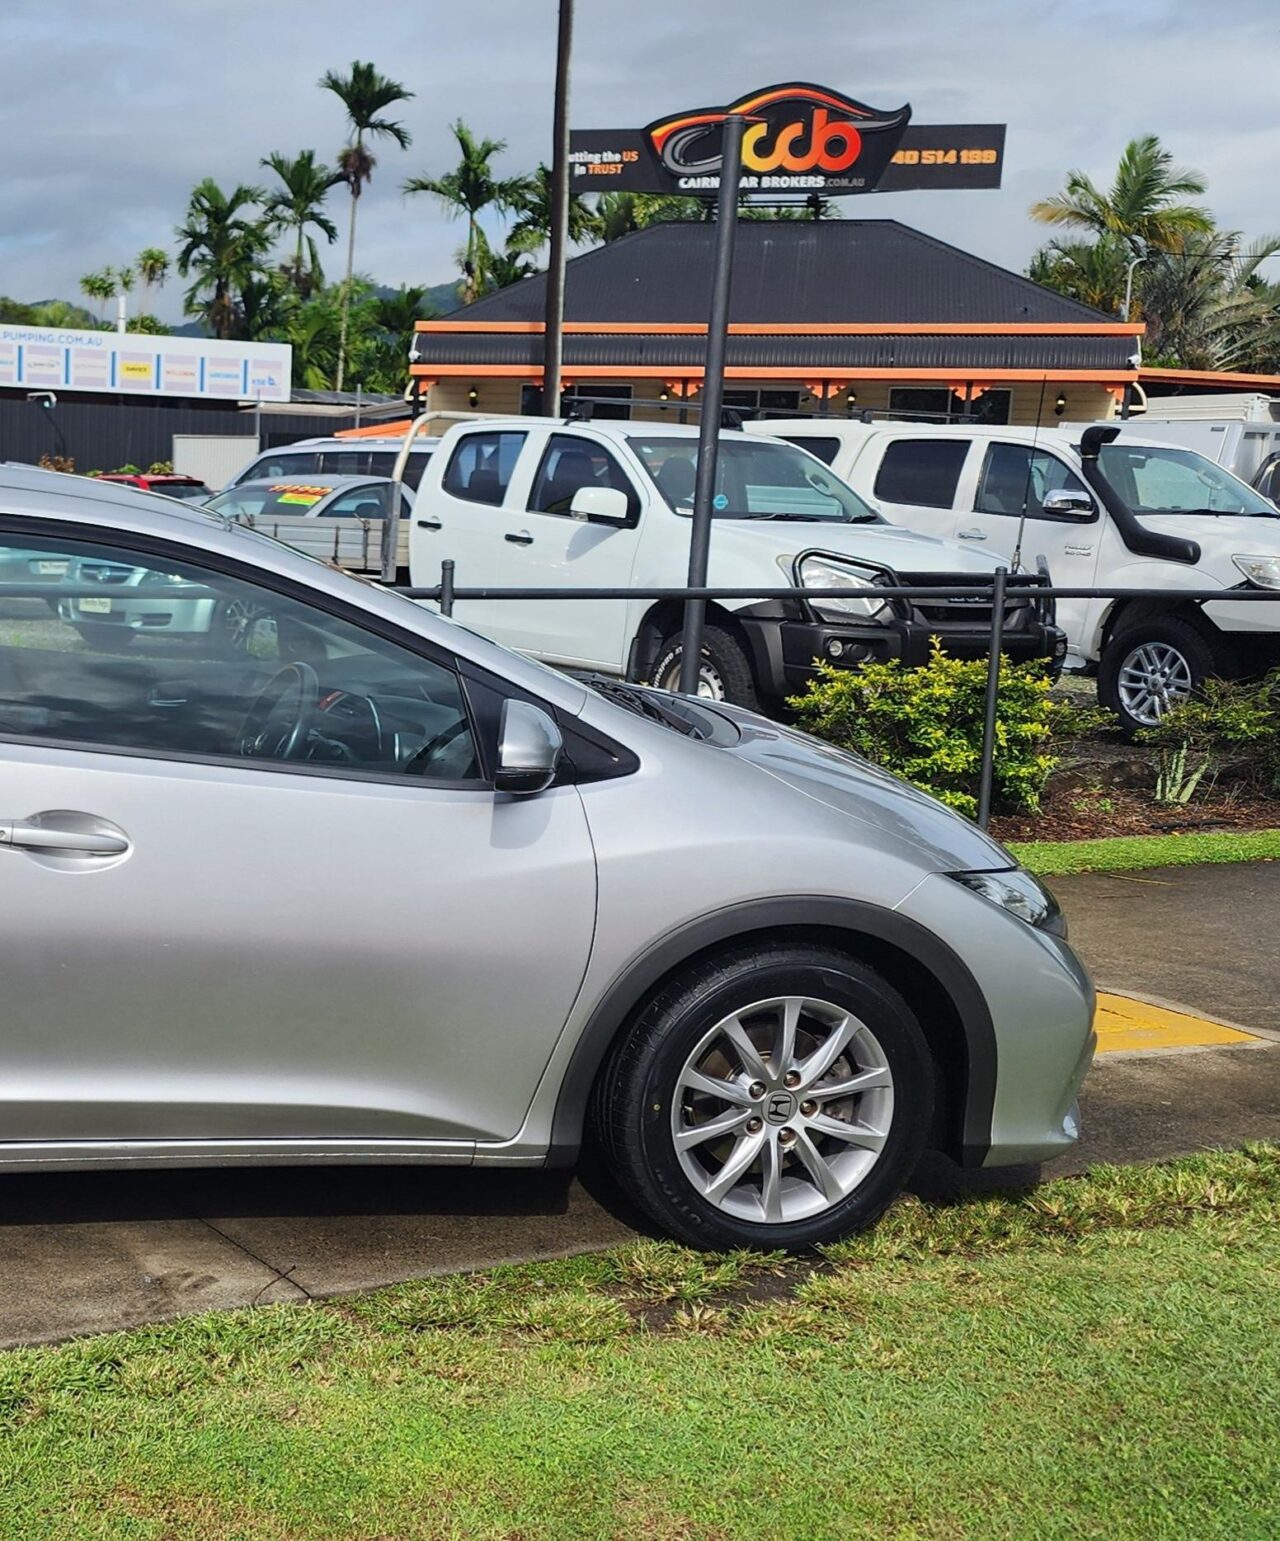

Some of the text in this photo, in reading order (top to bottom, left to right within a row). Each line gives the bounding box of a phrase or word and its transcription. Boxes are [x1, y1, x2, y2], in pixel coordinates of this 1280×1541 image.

[569, 150, 639, 164] utting the US
[891, 150, 997, 164] 40 514 199
[574, 164, 623, 175] in TRUST
[678, 177, 720, 188] CAIRN
[739, 176, 759, 188] AR
